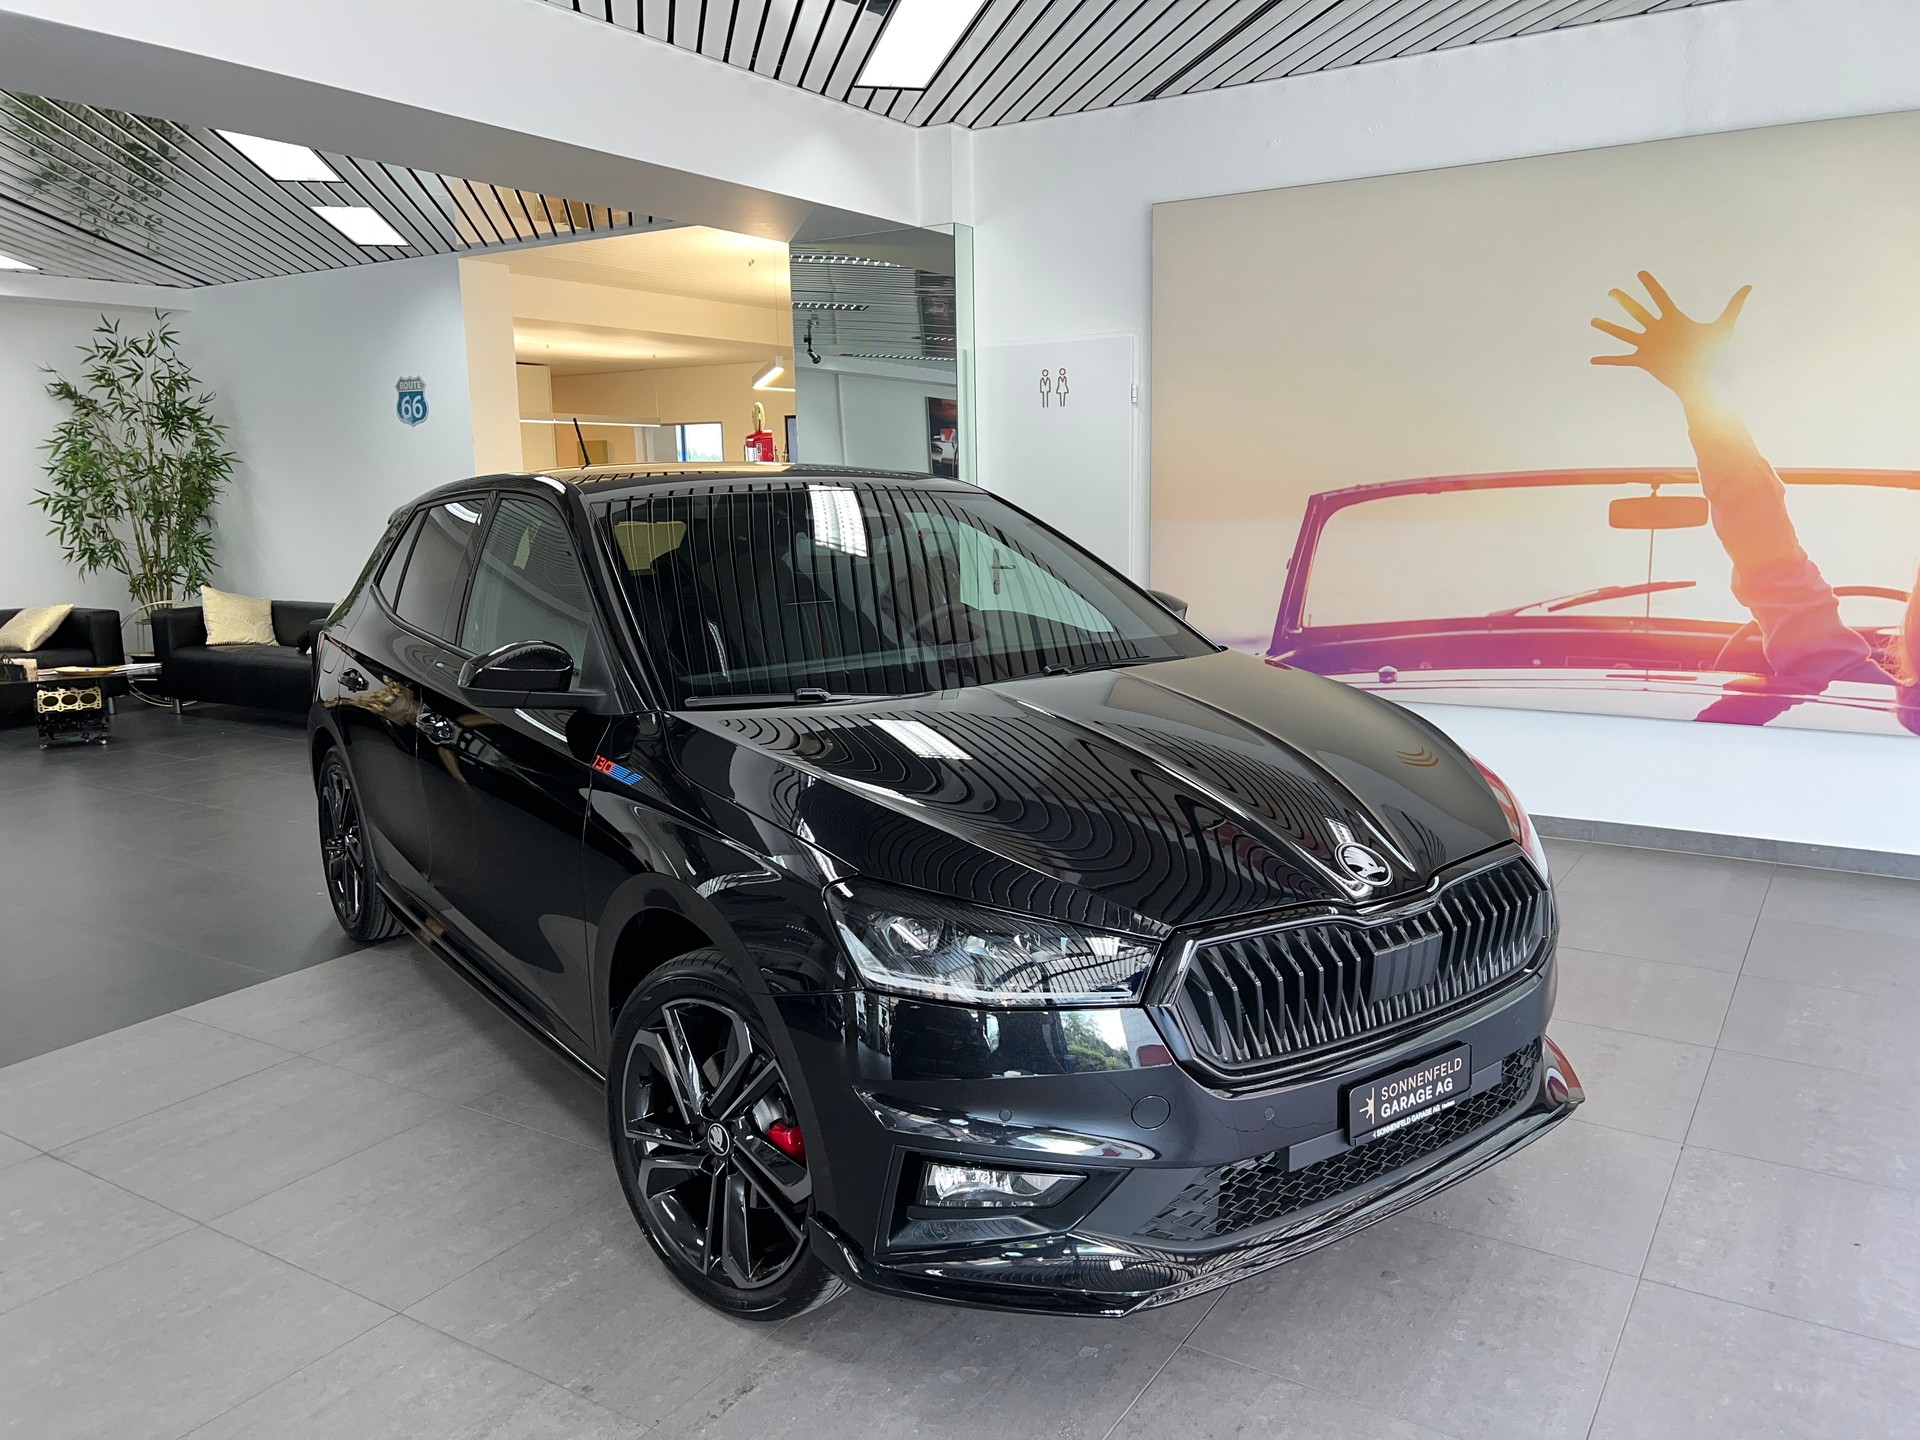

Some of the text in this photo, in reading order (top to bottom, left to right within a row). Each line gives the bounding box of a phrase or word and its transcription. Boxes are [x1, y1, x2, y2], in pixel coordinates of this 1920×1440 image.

[399, 381, 422, 390] ROUTE
[401, 395, 423, 419] 66
[592, 754, 614, 774] 130
[1381, 1057, 1462, 1101] SONNENFELD
[1381, 1077, 1453, 1118] GARAGE AG
[1376, 1117, 1411, 1137] SONNENFELD
[1411, 1107, 1432, 1122] GARAGE
[1432, 1104, 1441, 1113] AG
